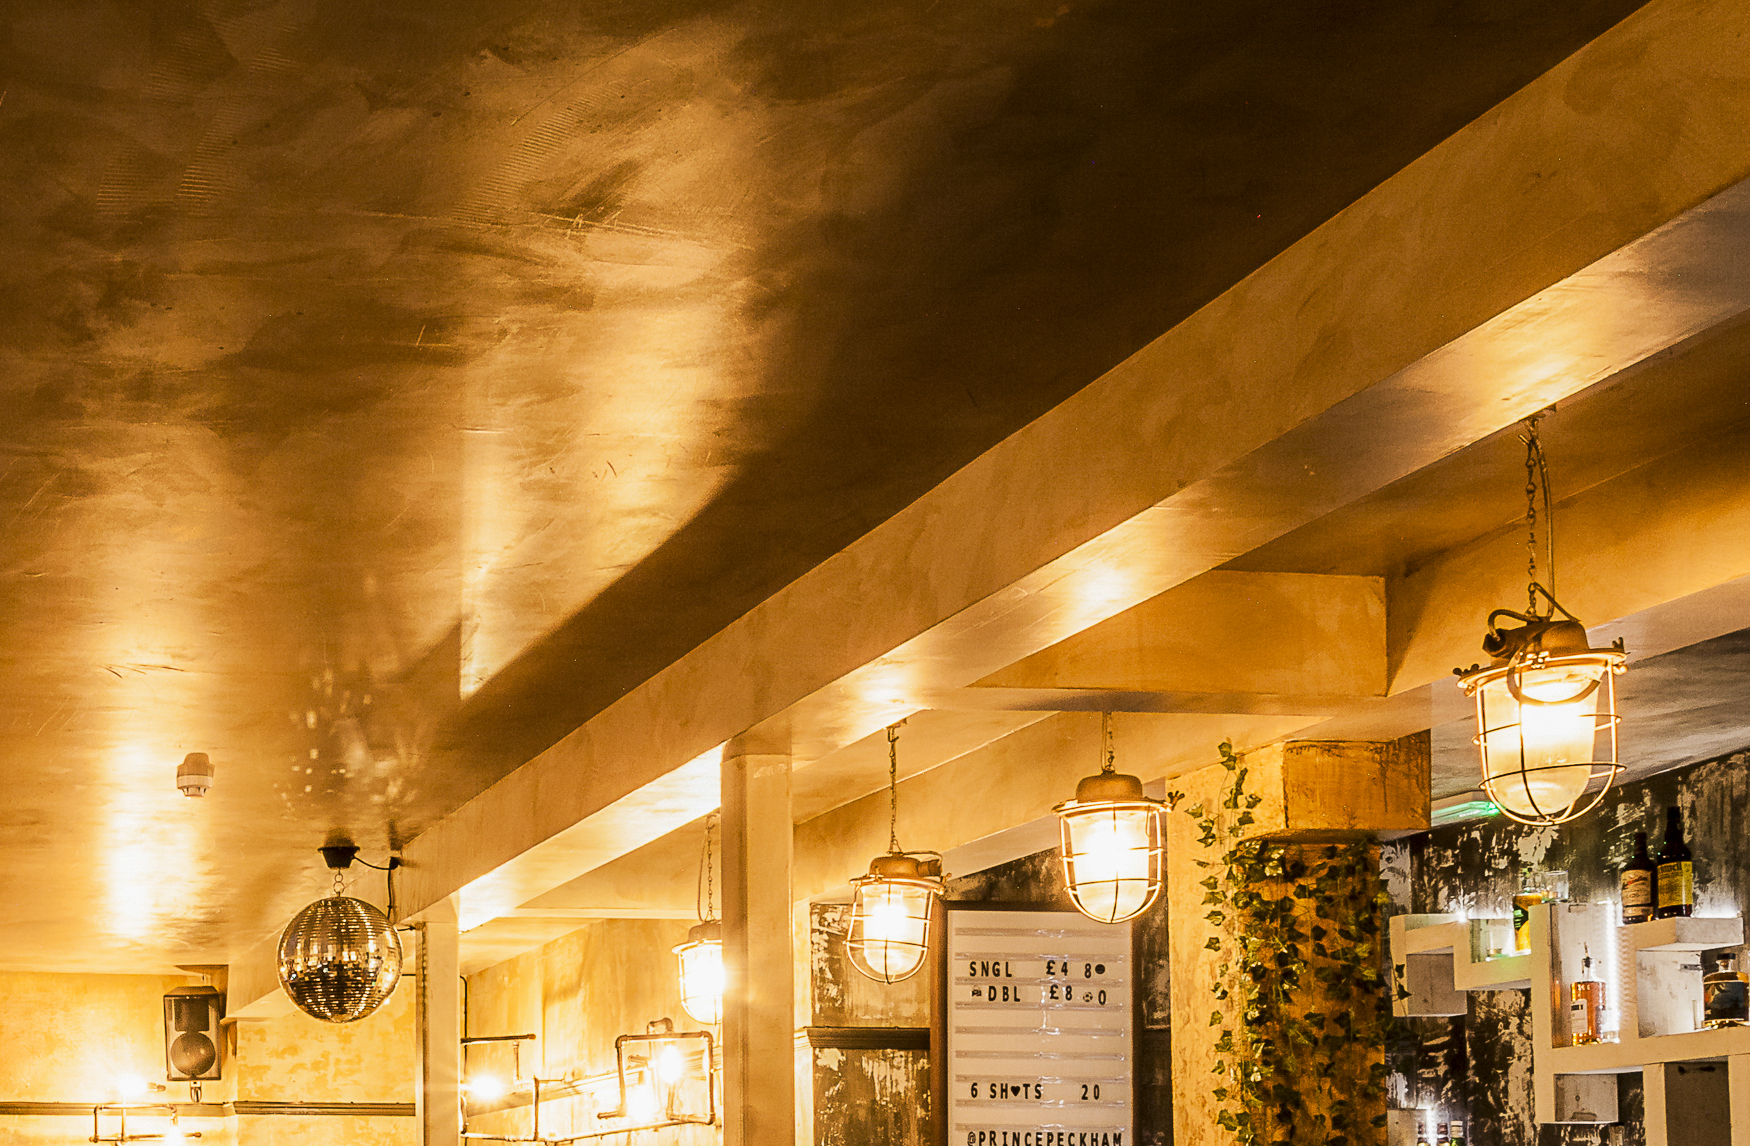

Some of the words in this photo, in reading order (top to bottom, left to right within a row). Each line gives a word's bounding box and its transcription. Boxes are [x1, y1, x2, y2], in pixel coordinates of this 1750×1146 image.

[969, 961, 1013, 978] SNGL
[988, 985, 1021, 1003] DBL
[970, 1082, 978, 1099] 6
[1081, 1084, 1100, 1101] 20
